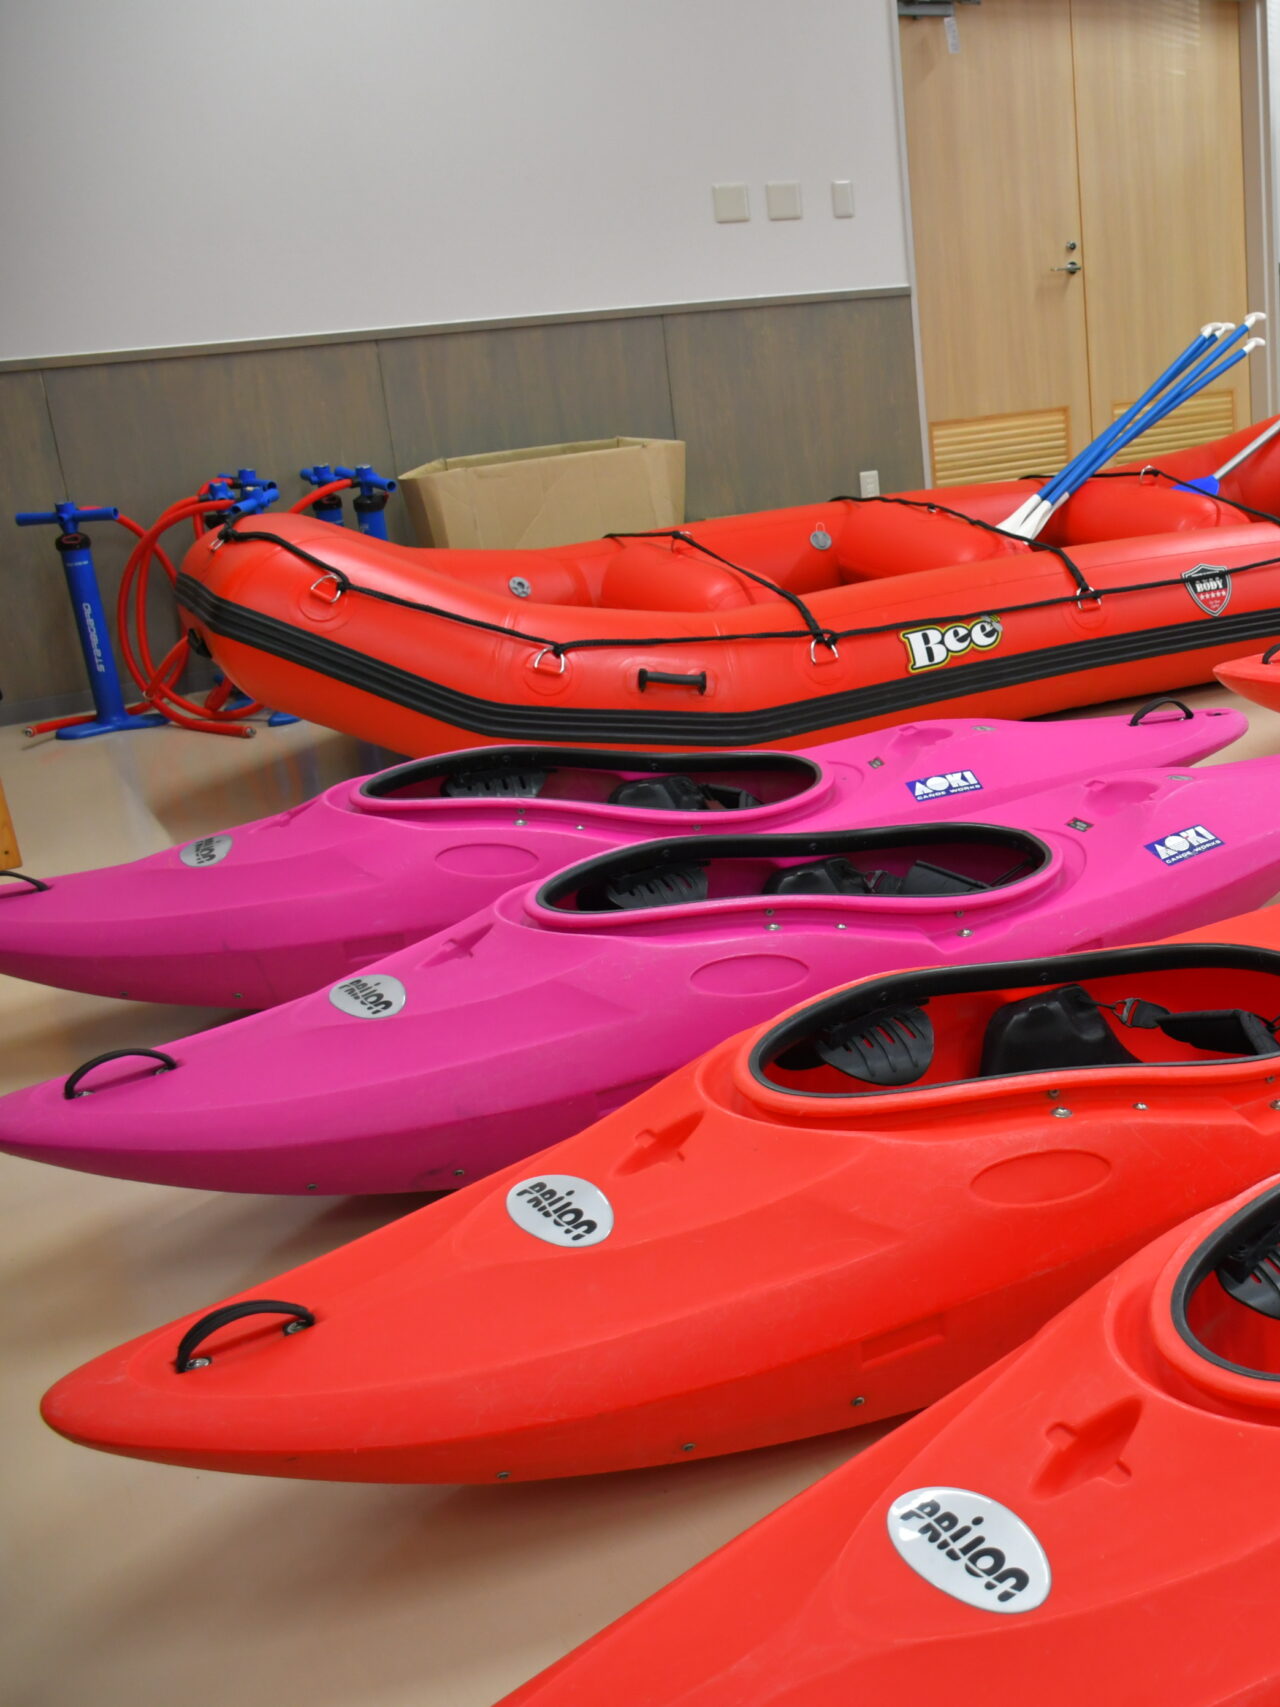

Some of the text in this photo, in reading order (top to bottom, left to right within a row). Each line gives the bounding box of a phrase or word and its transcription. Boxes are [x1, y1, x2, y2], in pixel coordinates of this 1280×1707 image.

[904, 618, 999, 670] Bee
[914, 770, 979, 796] AOKI
[916, 790, 947, 801] CANOE
[1154, 825, 1217, 860] AOKI
